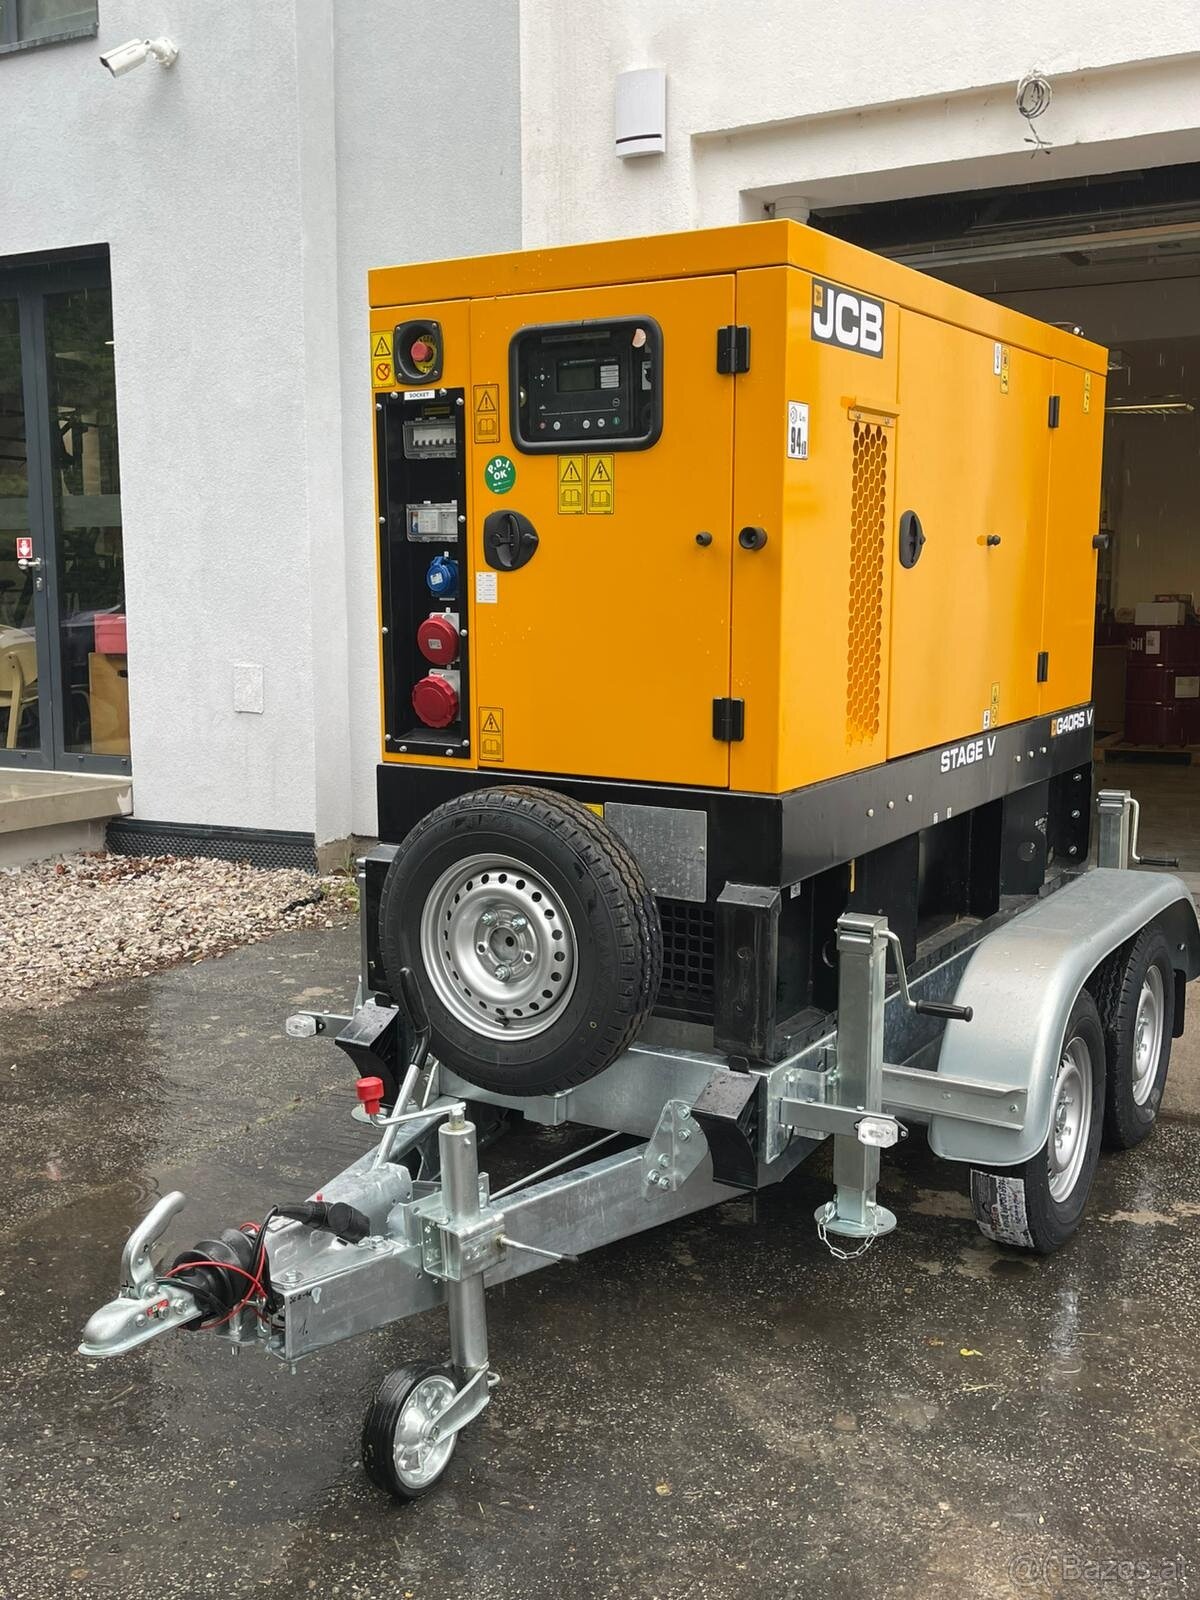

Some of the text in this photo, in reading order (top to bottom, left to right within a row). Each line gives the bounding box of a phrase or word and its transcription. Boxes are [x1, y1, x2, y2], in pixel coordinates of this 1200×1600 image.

[813, 288, 883, 353] JCB
[487, 458, 511, 475] P.D.I.
[493, 469, 508, 480] OK
[1056, 708, 1094, 735] G40RS V
[940, 735, 997, 773] STAGE V
